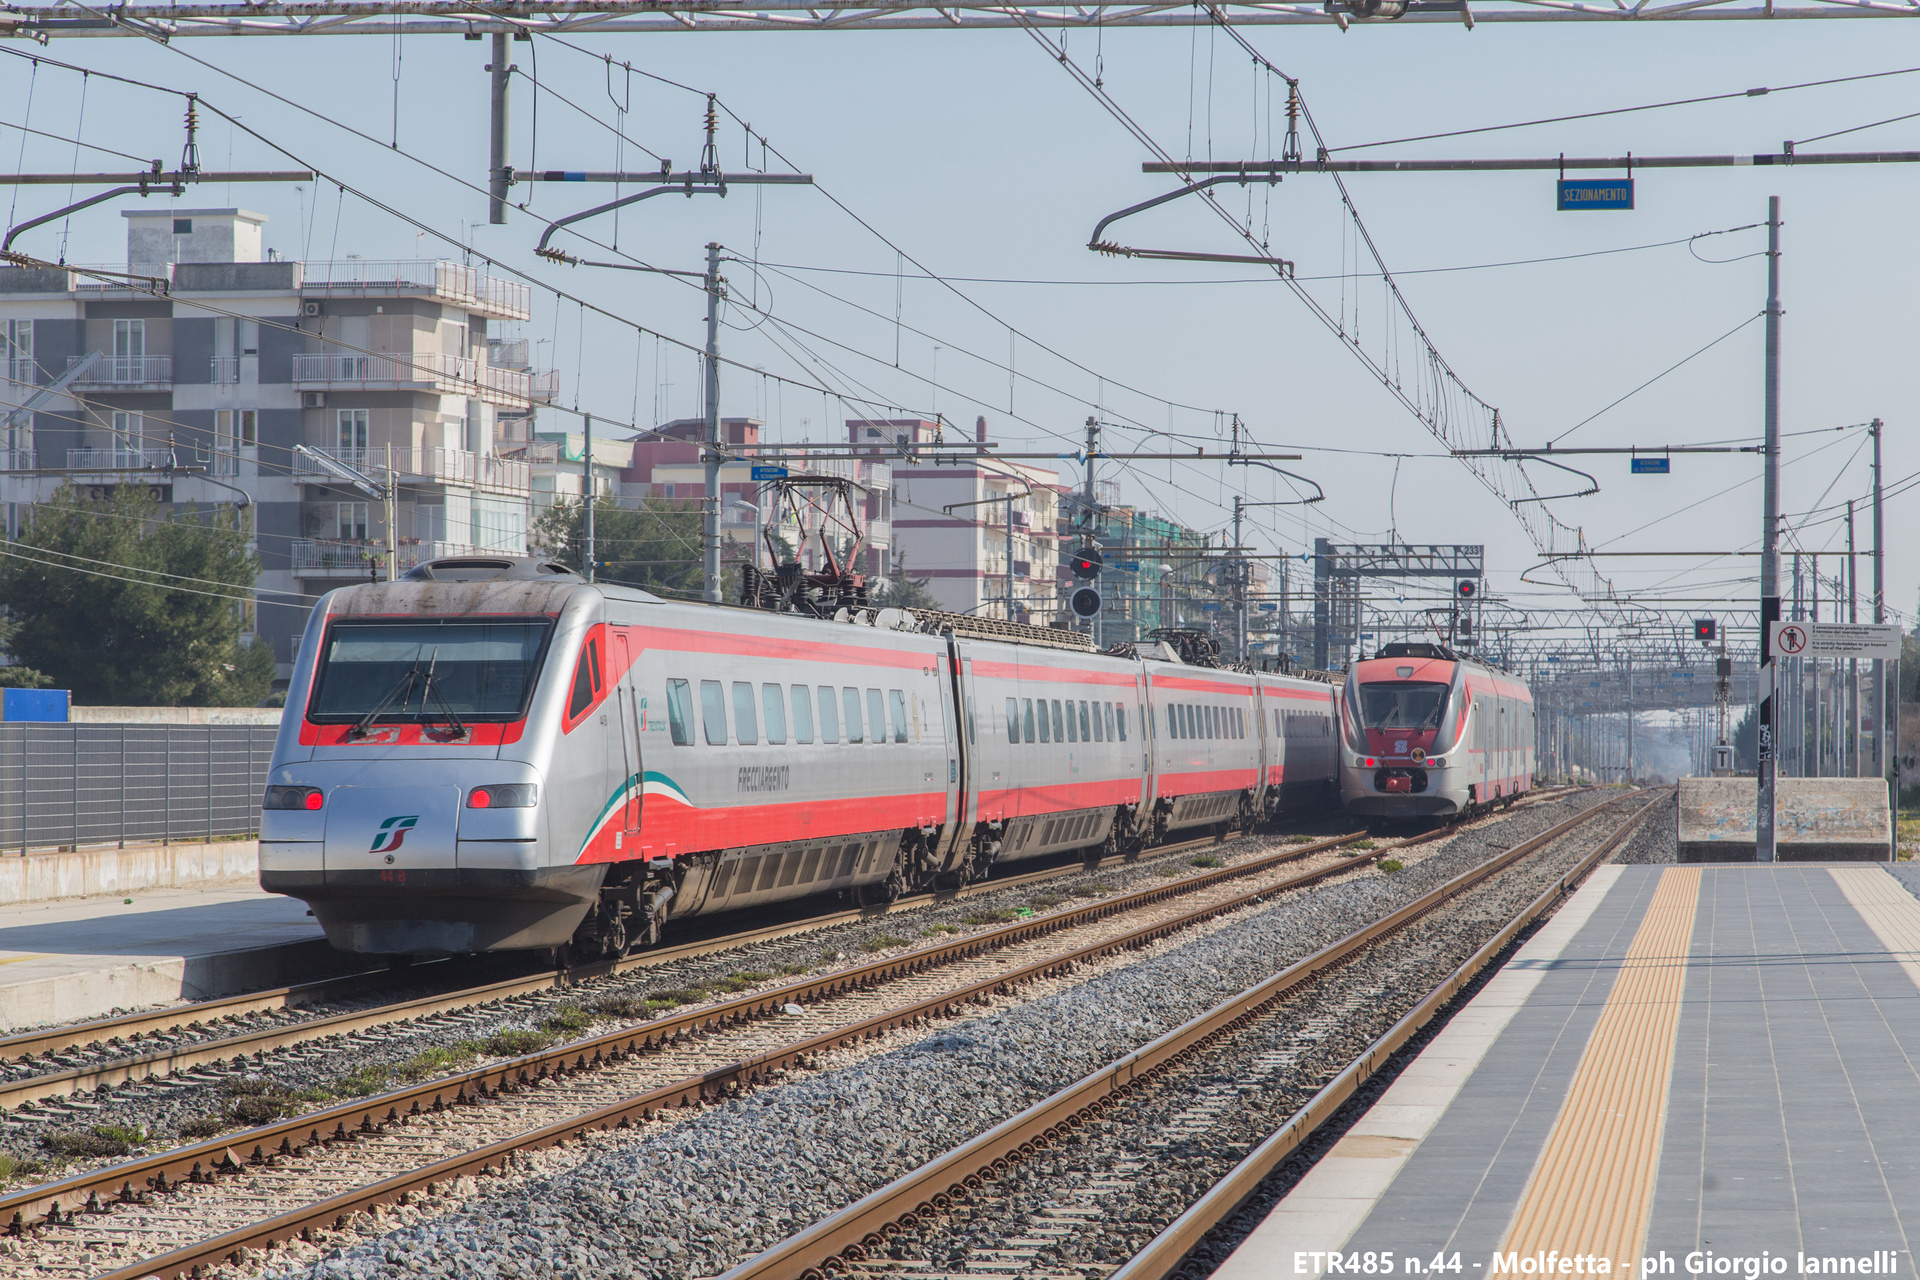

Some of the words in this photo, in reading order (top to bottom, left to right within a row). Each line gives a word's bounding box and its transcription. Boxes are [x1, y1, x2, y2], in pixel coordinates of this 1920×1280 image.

[1564, 188, 1626, 201] SEZIONAMENTO
[1464, 546, 1478, 554] 233
[1718, 751, 1727, 767] T
[738, 765, 790, 792] FRECCIARGENTO
[380, 870, 393, 882] 44
